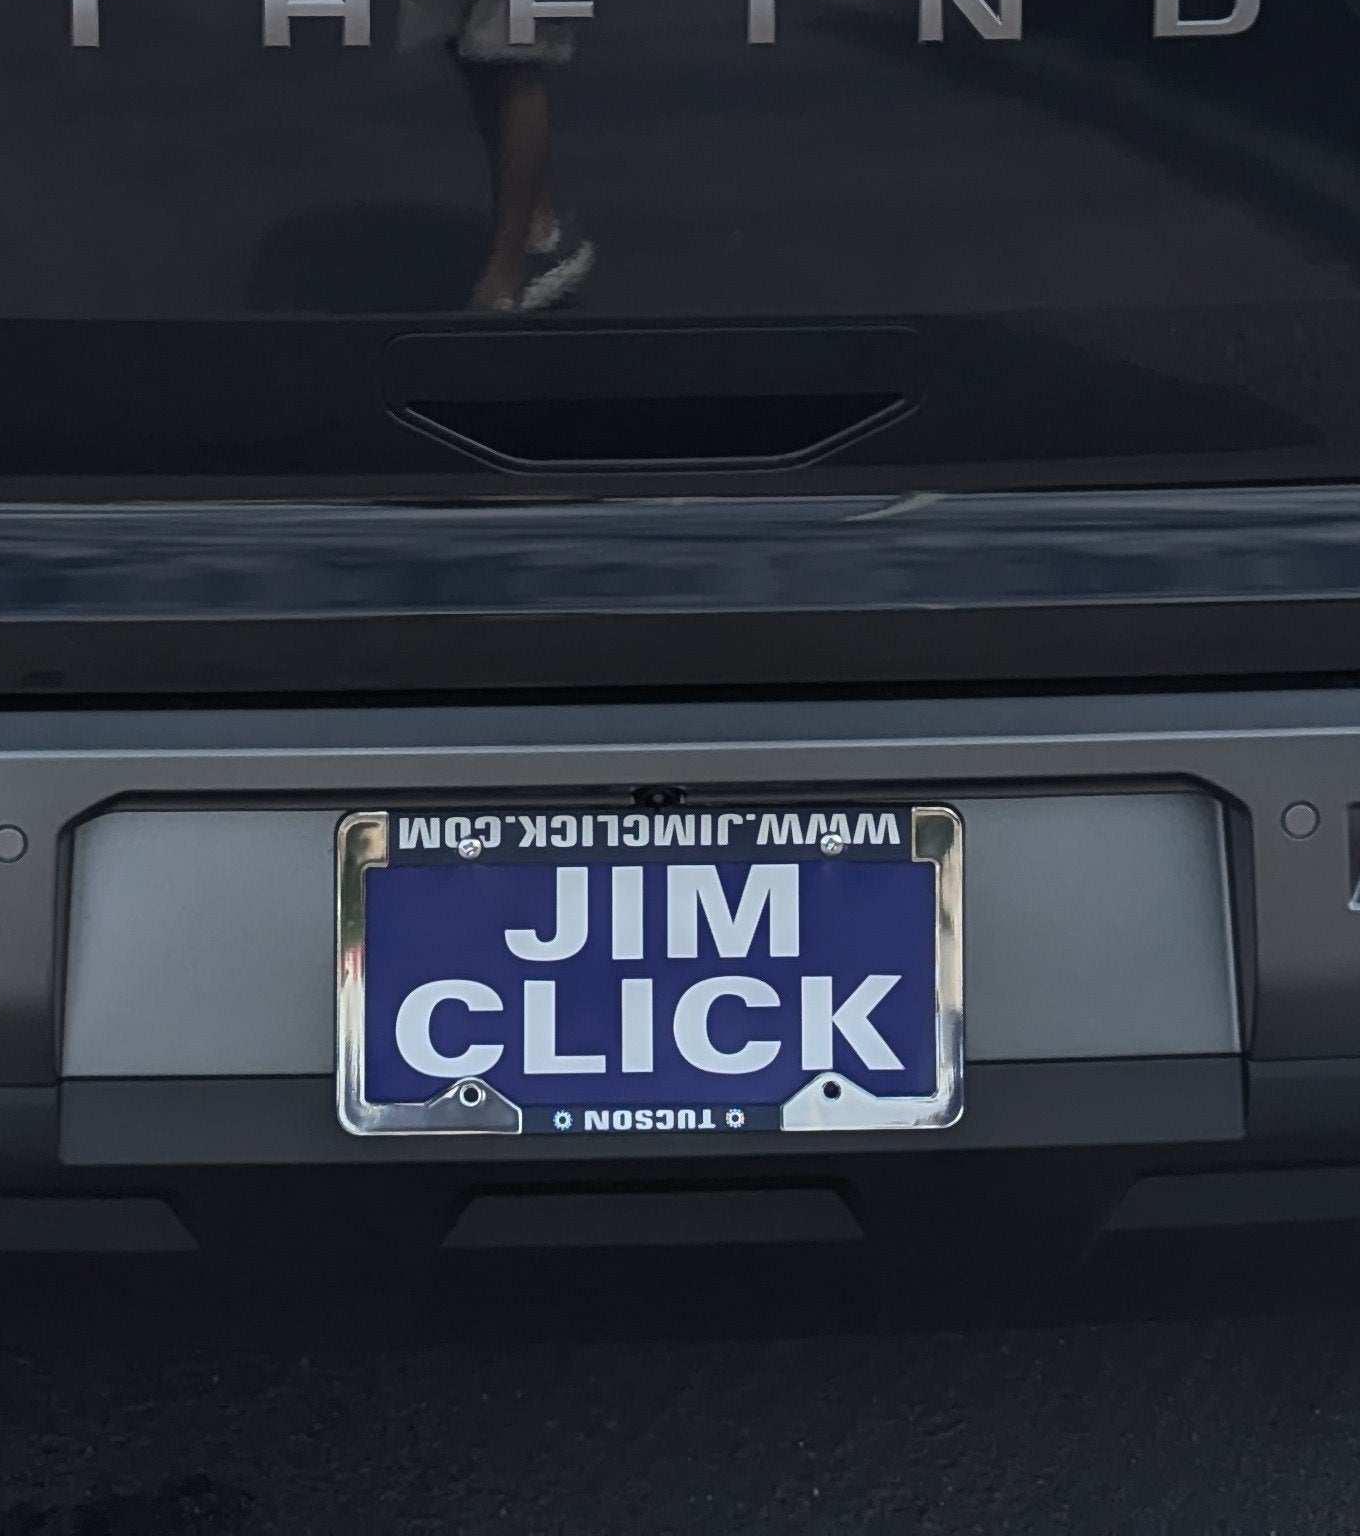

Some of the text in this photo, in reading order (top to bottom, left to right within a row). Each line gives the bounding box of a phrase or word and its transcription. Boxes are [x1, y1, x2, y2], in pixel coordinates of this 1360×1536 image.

[398, 813, 901, 850] WWW.JIMCLICK.COM
[504, 863, 800, 962] JIM
[394, 974, 906, 1079] CLICK
[584, 1108, 717, 1131] TUCSON
